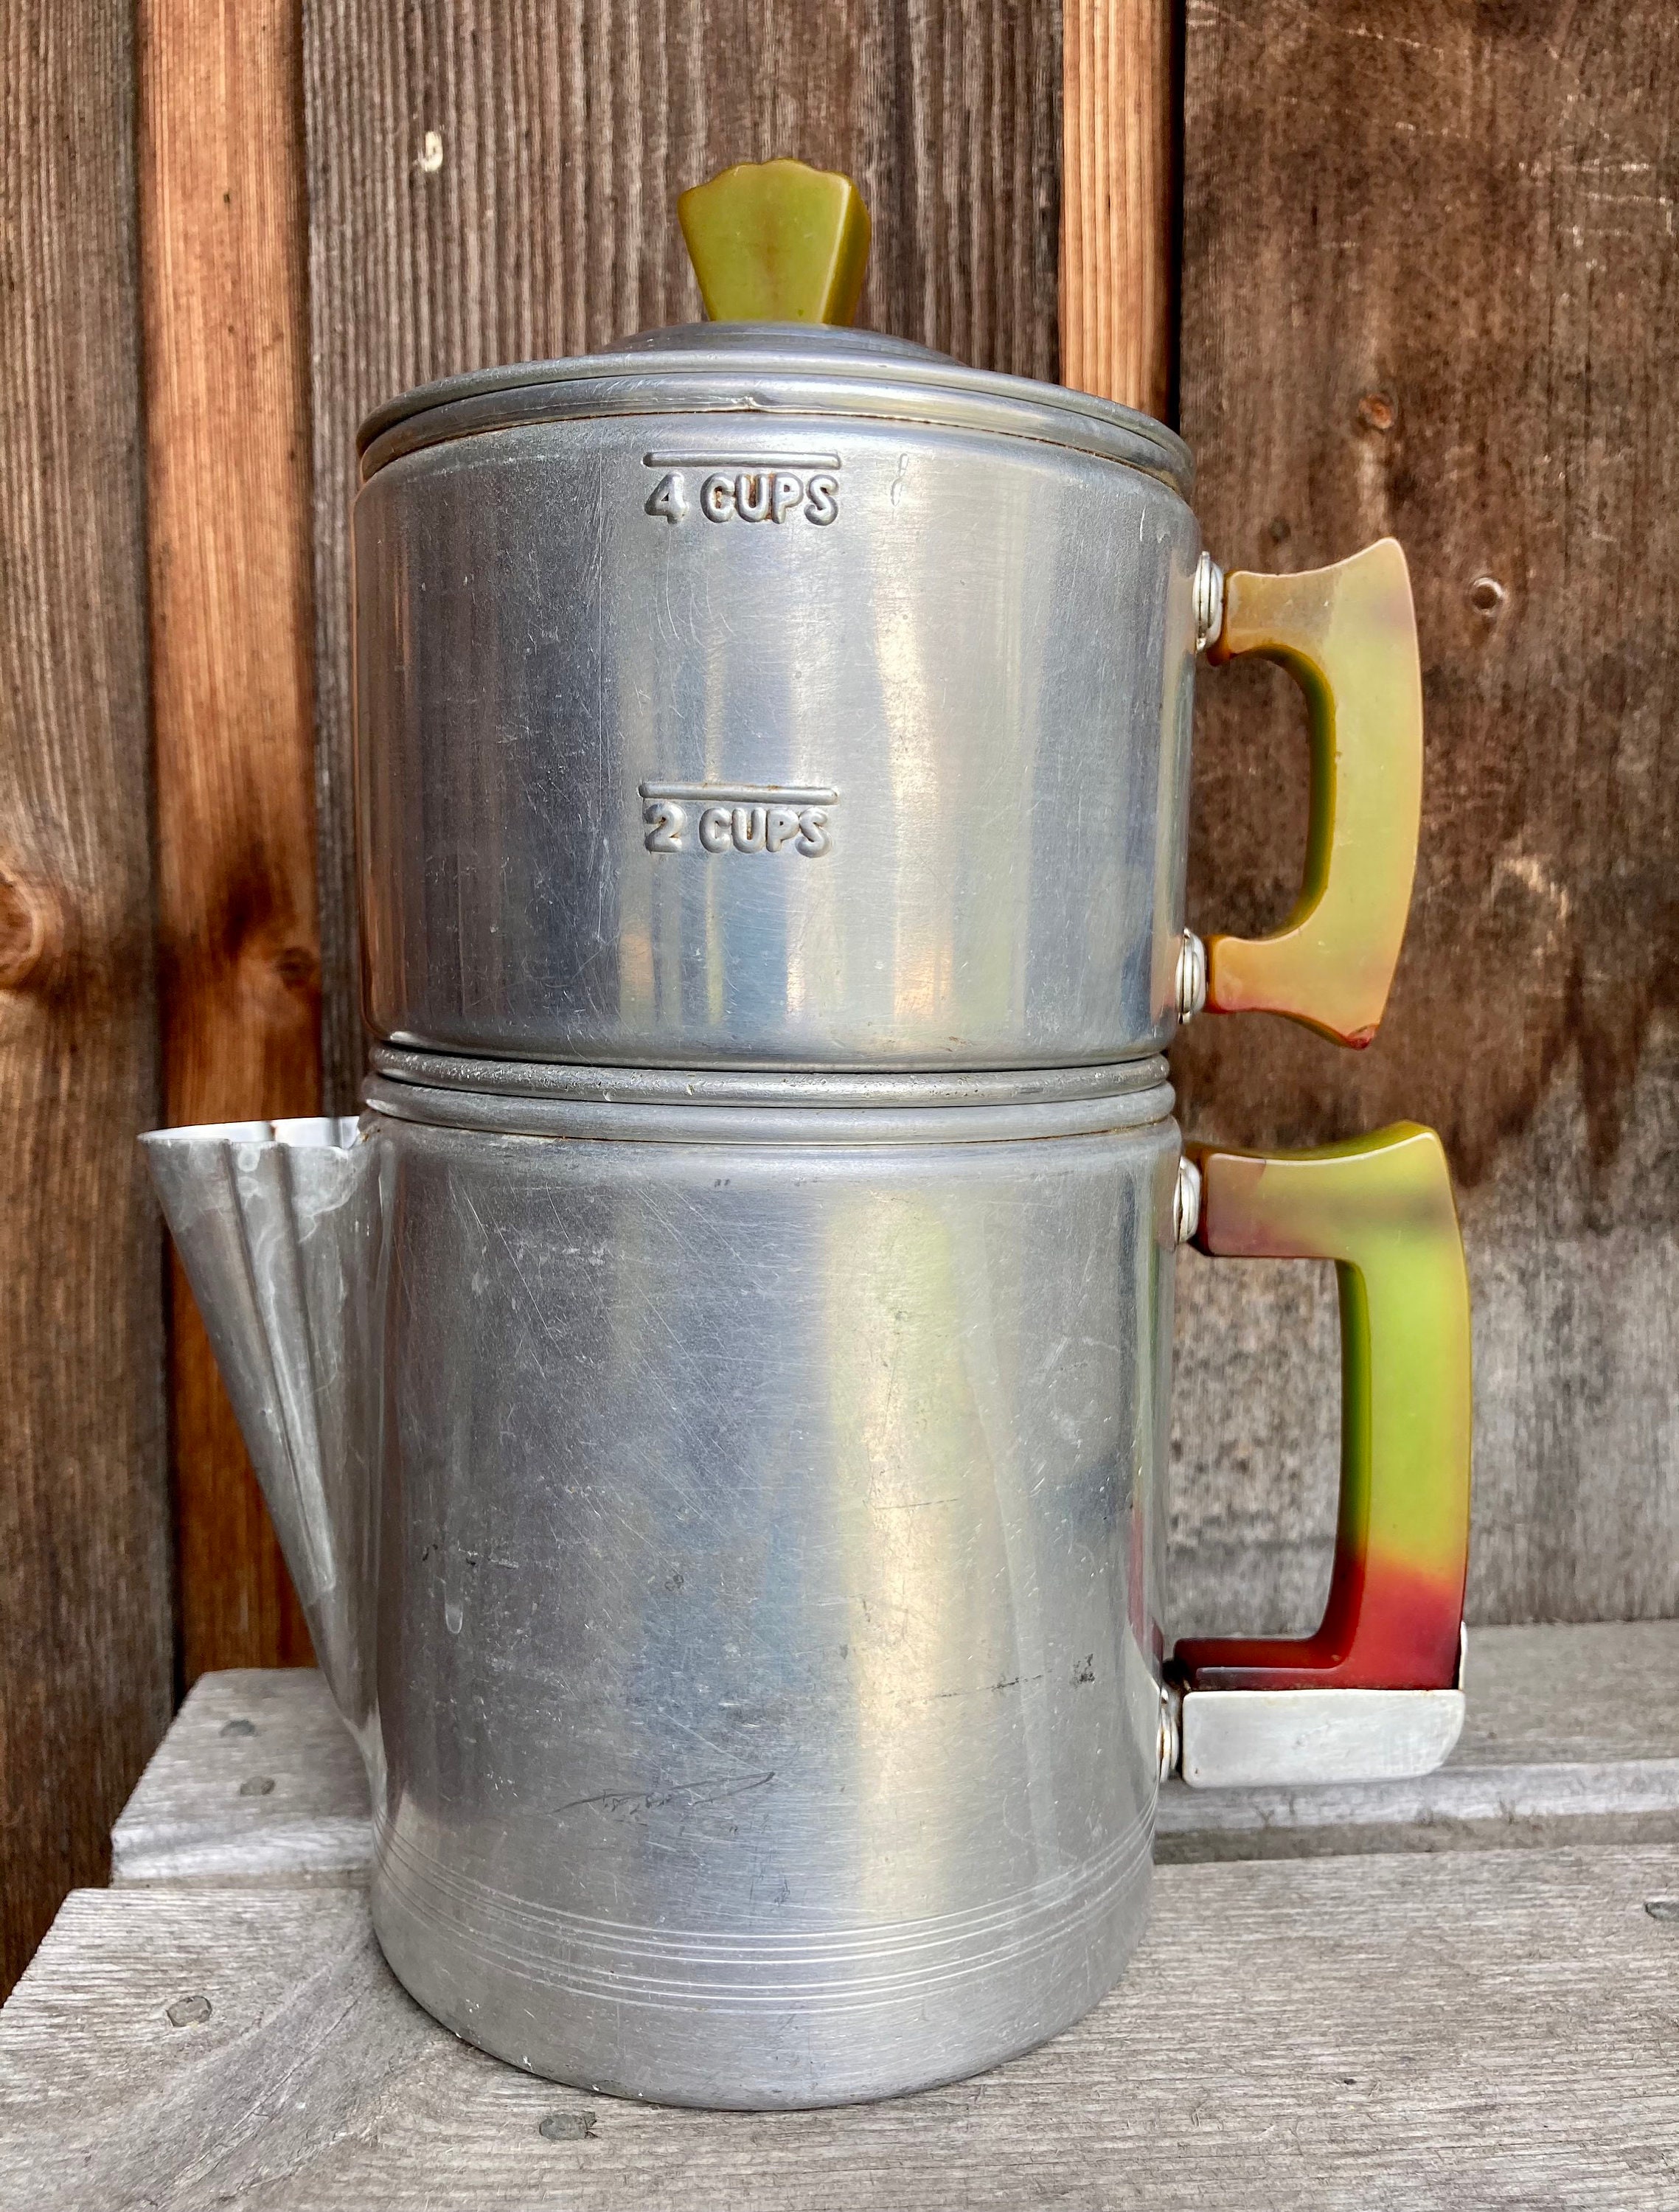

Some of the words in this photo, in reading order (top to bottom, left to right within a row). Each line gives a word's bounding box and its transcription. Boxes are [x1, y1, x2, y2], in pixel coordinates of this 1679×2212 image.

[644, 471, 689, 524] 4
[701, 471, 839, 526] CUPS
[643, 801, 686, 853] 2
[699, 807, 834, 858] CUPS
